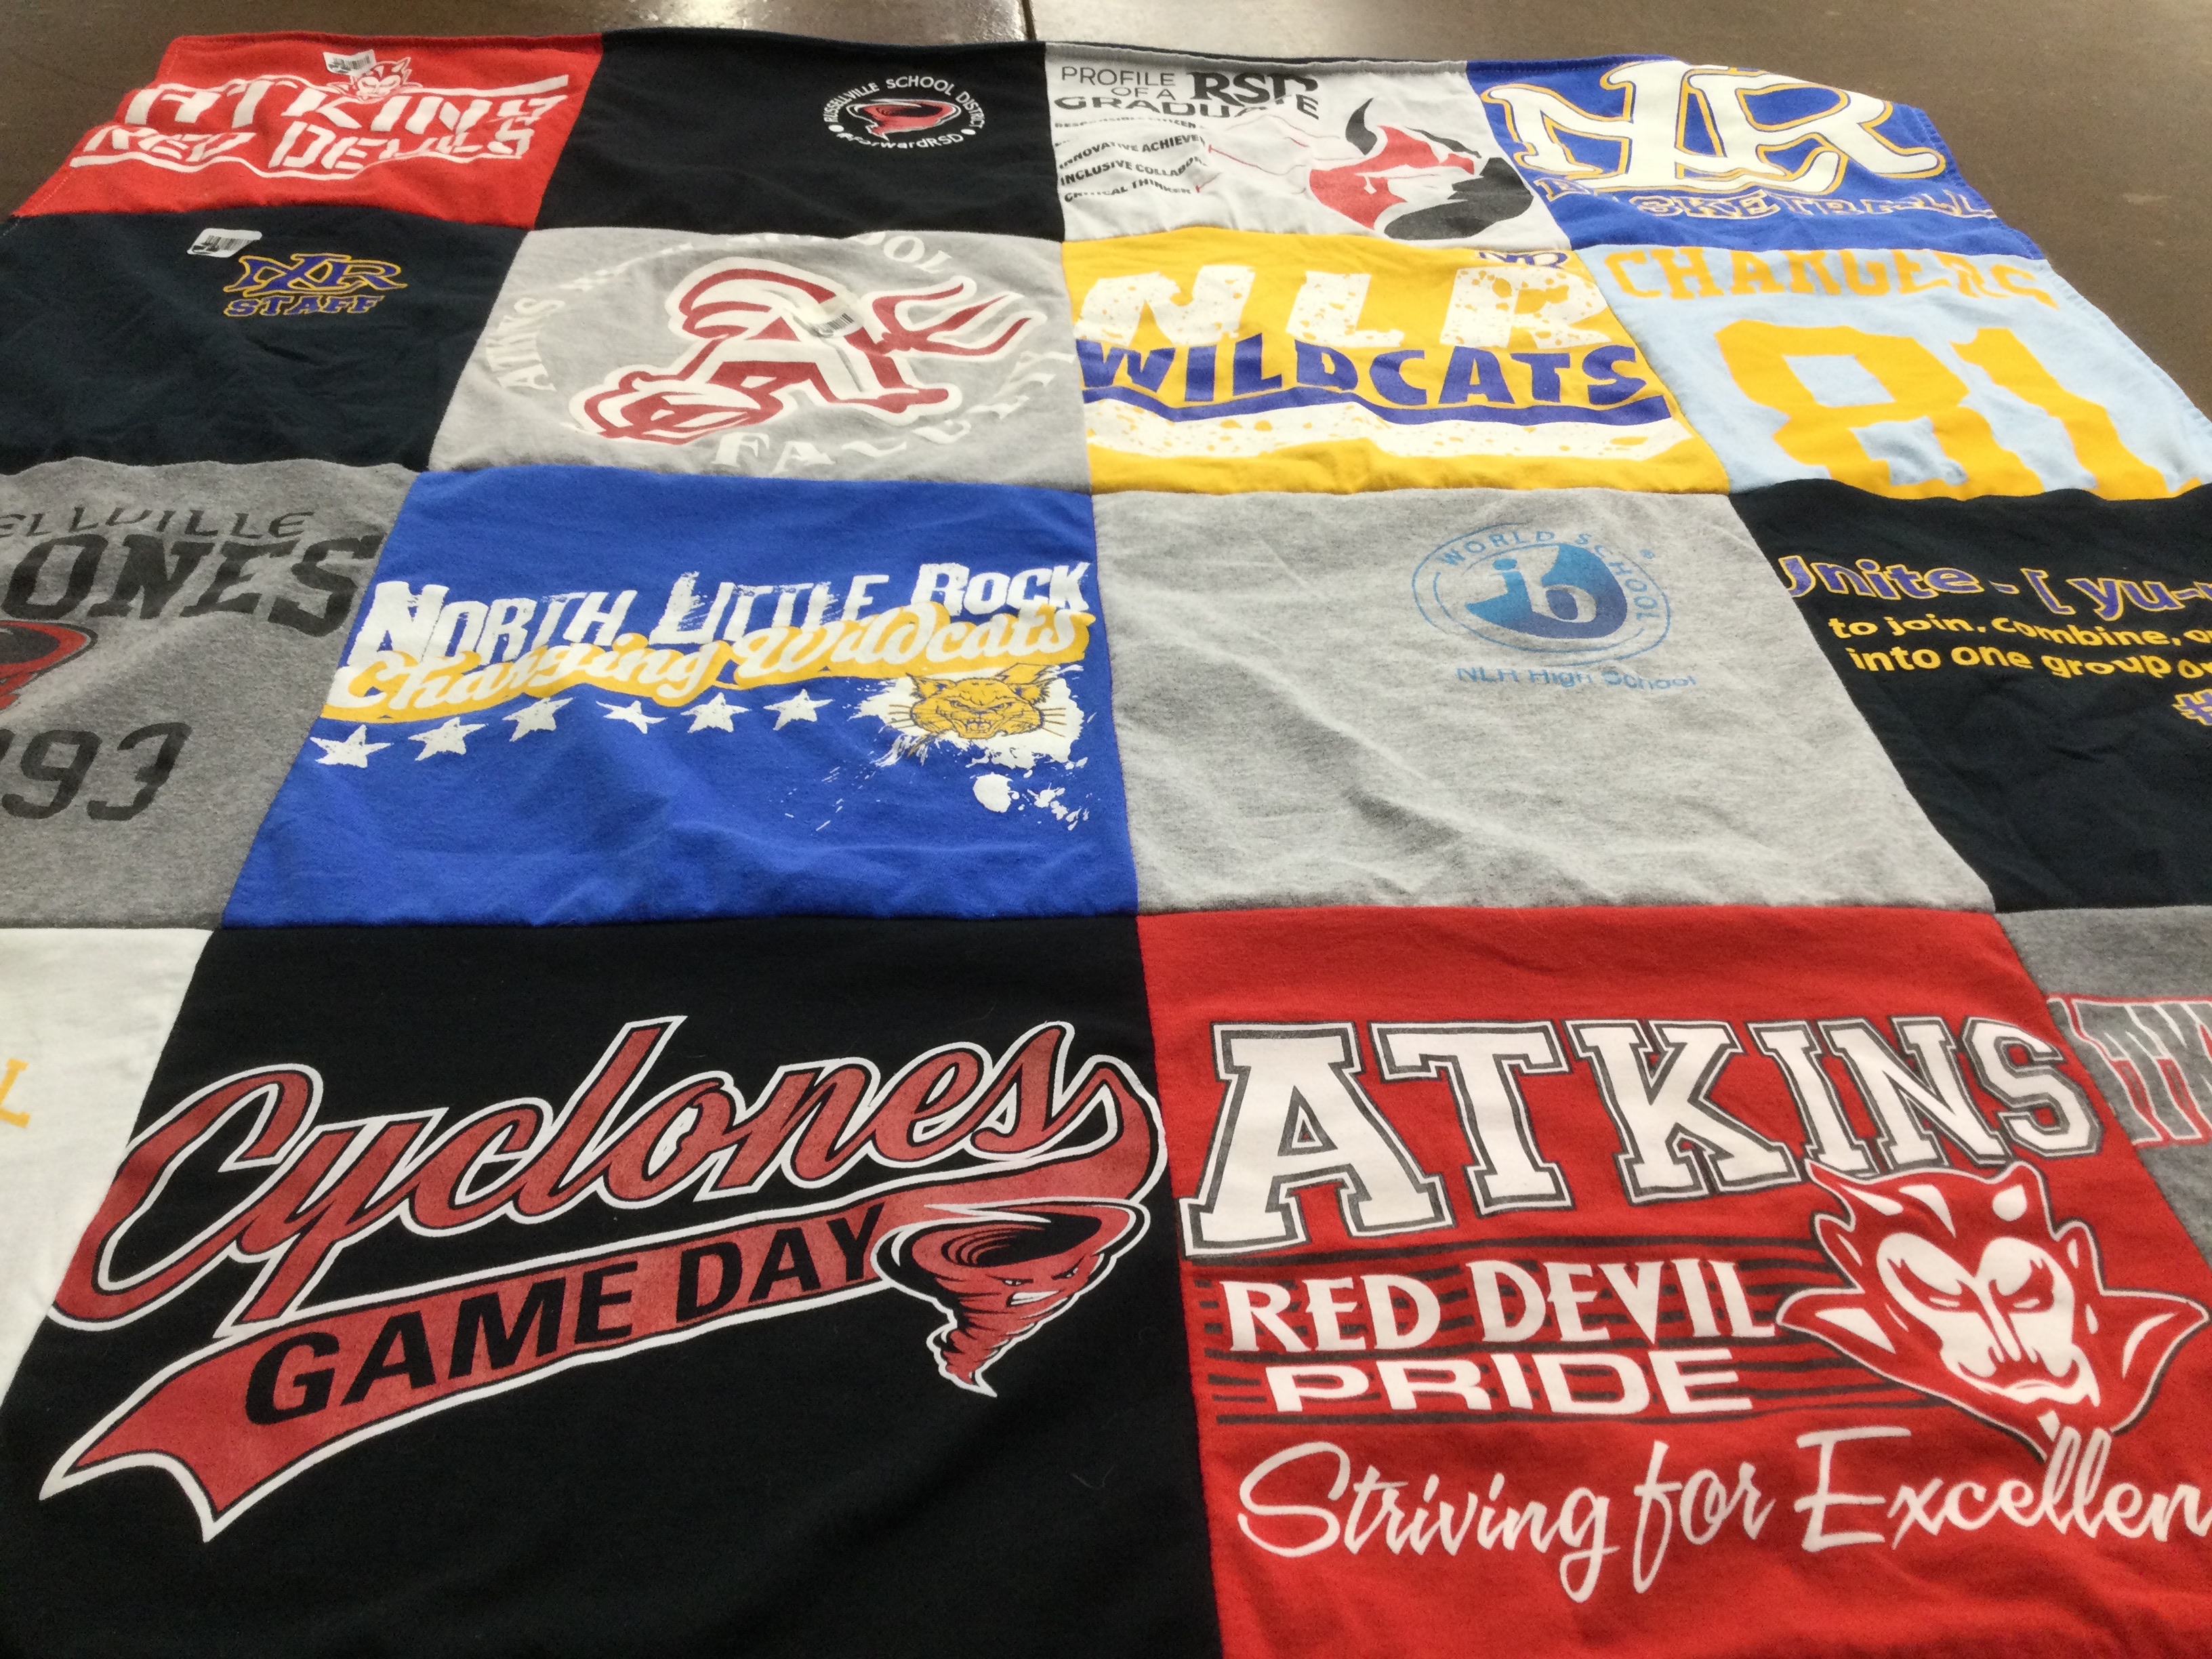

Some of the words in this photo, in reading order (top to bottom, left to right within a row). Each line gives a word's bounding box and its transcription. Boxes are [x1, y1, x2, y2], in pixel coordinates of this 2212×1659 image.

[885, 75, 955, 96] SCHOOL
[956, 91, 985, 129] DISTRICT
[1061, 66, 1176, 87] PROFILE
[1111, 87, 1149, 98] OF
[1156, 88, 1176, 101] A
[1060, 160, 1133, 186] INCLUSIVE
[223, 295, 386, 317] STAFF
[1076, 265, 1612, 351] NLR
[1603, 246, 2060, 309] CHARGERS
[1075, 333, 1647, 406] WILDCATS
[1714, 319, 2203, 501] 81
[346, 579, 638, 667] NORTH
[649, 571, 890, 644] LITTLE
[911, 562, 1092, 616] ROCK
[1436, 530, 1555, 567] WORLD
[1576, 532, 1660, 621] SCHOOL
[325, 634, 725, 712] Charging
[732, 602, 1095, 680] Wildcats
[1828, 617, 1879, 639] to
[1990, 617, 2183, 647] combine,
[1845, 646, 1942, 672] into
[1950, 647, 2033, 670] one
[2041, 655, 2172, 679] group
[0, 722, 192, 822] 93
[49, 1015, 1169, 1338] Cyclones
[1179, 1016, 2106, 1262] ATKINS
[245, 1258, 637, 1427] GAME
[676, 1200, 889, 1328] DAY
[1219, 1274, 1442, 1353] RED
[1466, 1258, 1776, 1345] DEVIL
[1264, 1348, 1754, 1417] PRIDE
[1237, 1441, 1622, 1603] Striving
[1632, 1439, 1777, 1595] for
[1792, 1426, 2212, 1553] Excellen
